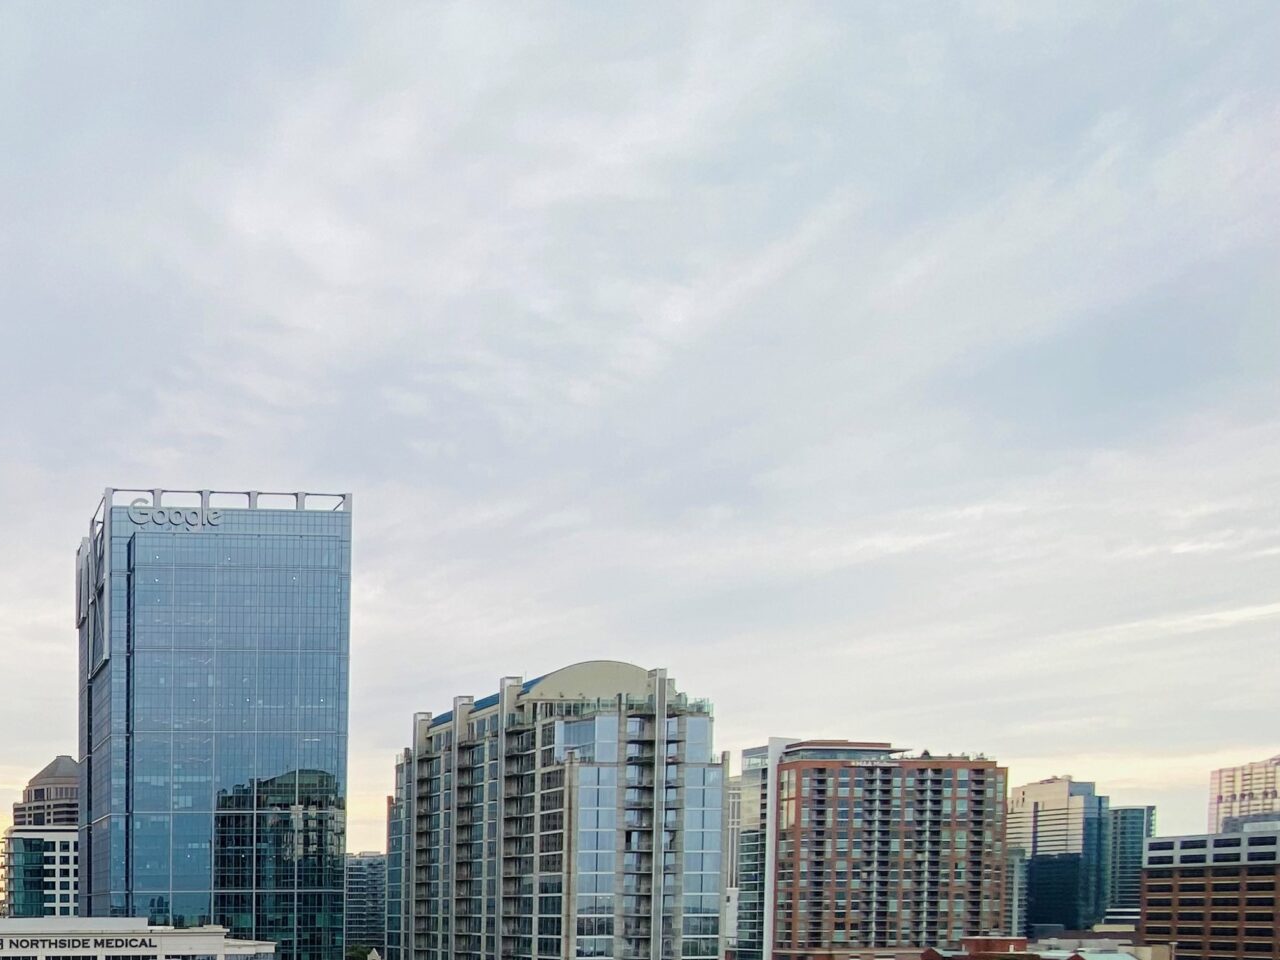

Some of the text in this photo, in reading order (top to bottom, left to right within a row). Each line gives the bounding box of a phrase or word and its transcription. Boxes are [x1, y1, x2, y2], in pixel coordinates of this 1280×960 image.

[128, 498, 224, 532] Google
[9, 938, 157, 949] NORTHSIDE MEDICAL
